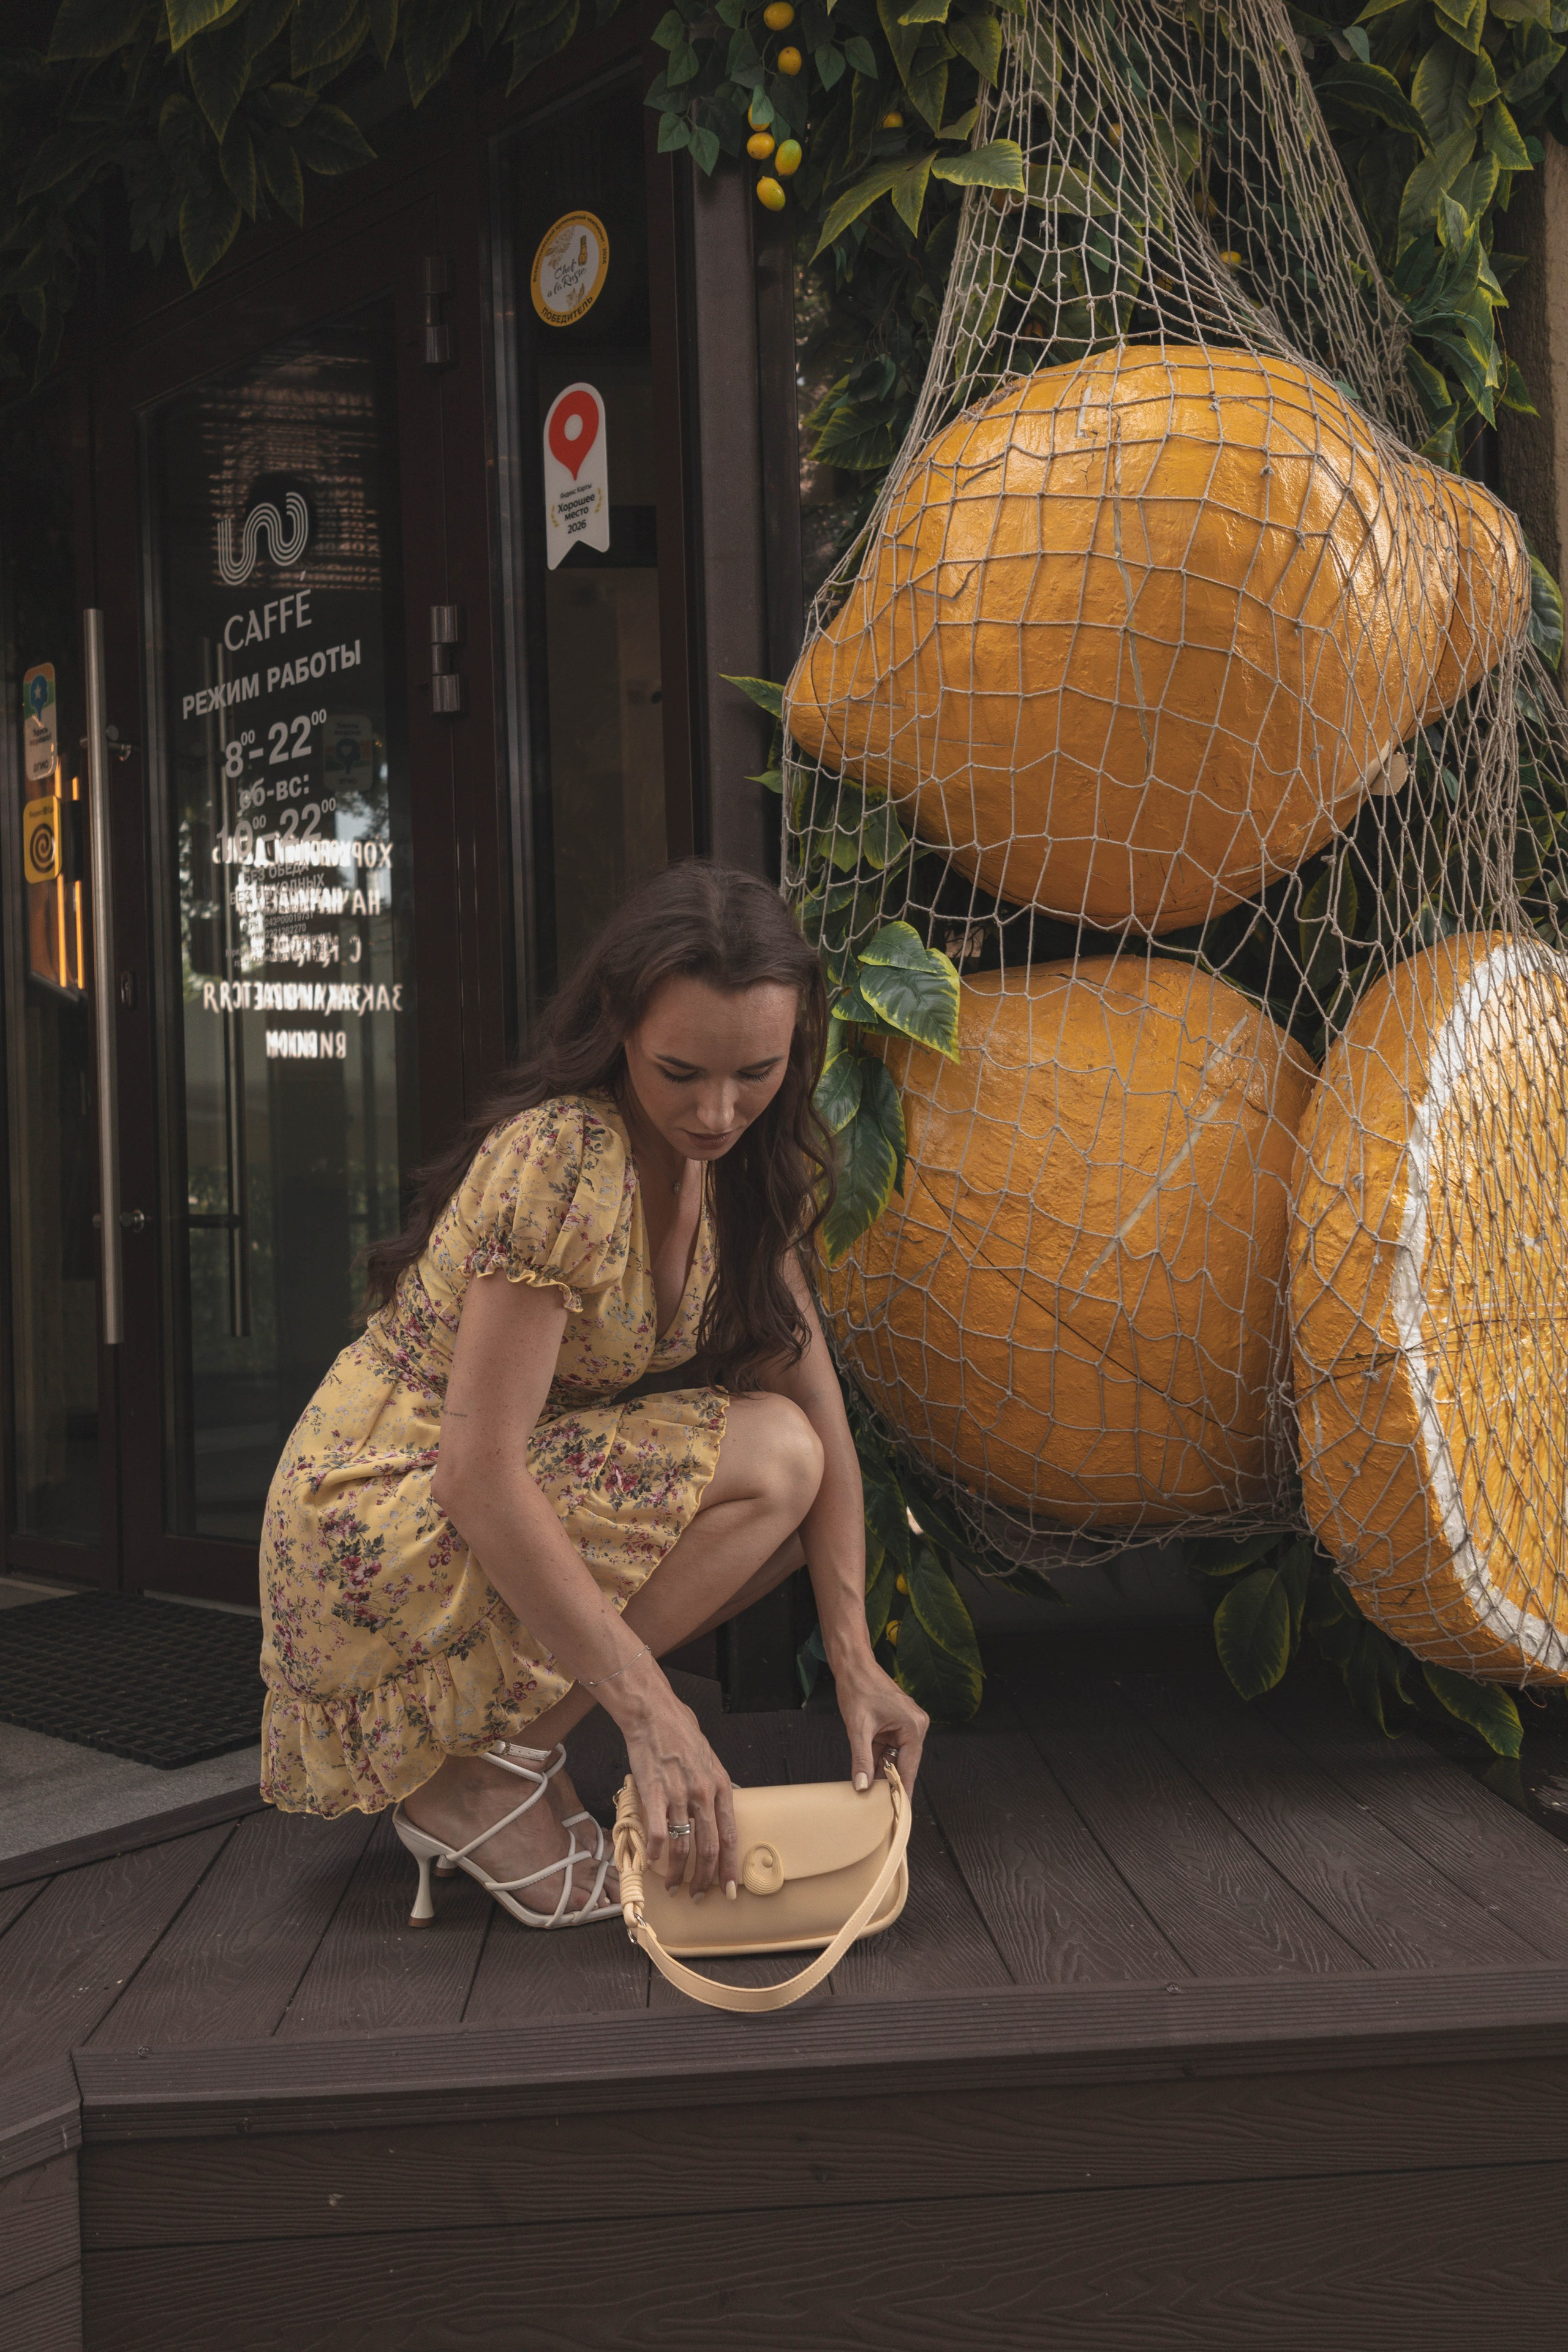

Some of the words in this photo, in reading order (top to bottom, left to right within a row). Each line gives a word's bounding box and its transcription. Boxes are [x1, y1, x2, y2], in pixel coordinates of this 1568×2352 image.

[541, 296, 593, 325] ПОБЕДИТЕЛЬ
[560, 489, 576, 499] Яндекс
[576, 483, 592, 492] Карты
[557, 494, 595, 514] Хорошее
[564, 507, 589, 521] место
[567, 519, 587, 534] 2026
[183, 673, 260, 720] РЕЖИМ
[267, 639, 361, 693] РАБОТЫ
[268, 861, 309, 880] ОБЕДА
